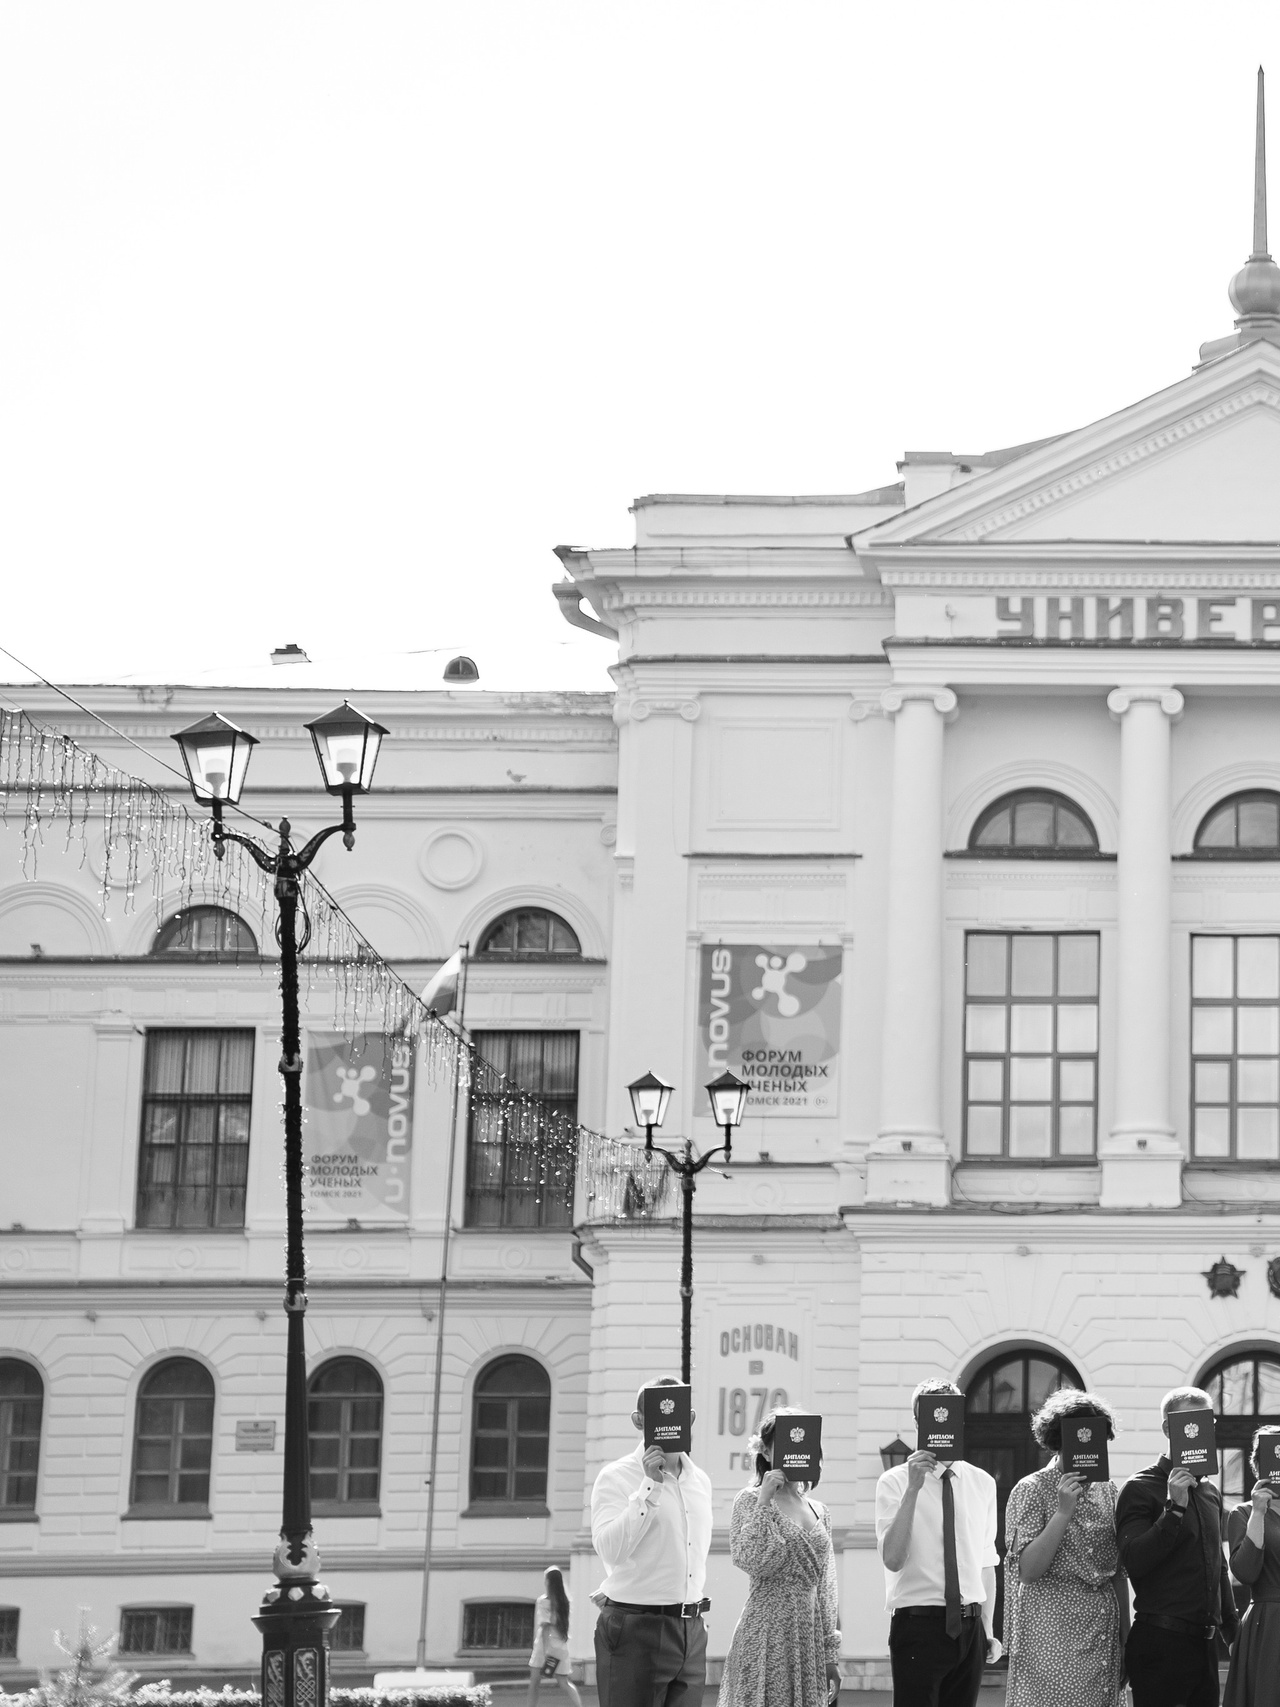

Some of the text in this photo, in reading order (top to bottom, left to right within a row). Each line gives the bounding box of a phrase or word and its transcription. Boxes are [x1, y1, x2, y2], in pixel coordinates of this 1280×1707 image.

[742, 1050, 802, 1062] ФОРУМ
[741, 1065, 828, 1079] МОЛОДЫХ
[746, 1097, 780, 1105] ОМСК
[783, 1097, 807, 1105] 2021
[311, 1154, 358, 1164] ФОРУМ
[310, 1166, 378, 1177] МОЛОДЫХ
[310, 1177, 362, 1188] УЧЕНЫХ
[720, 1324, 798, 1361] ОСНОВАН
[749, 1360, 763, 1375] В
[1181, 1449, 1207, 1457] ДИПЛОМ
